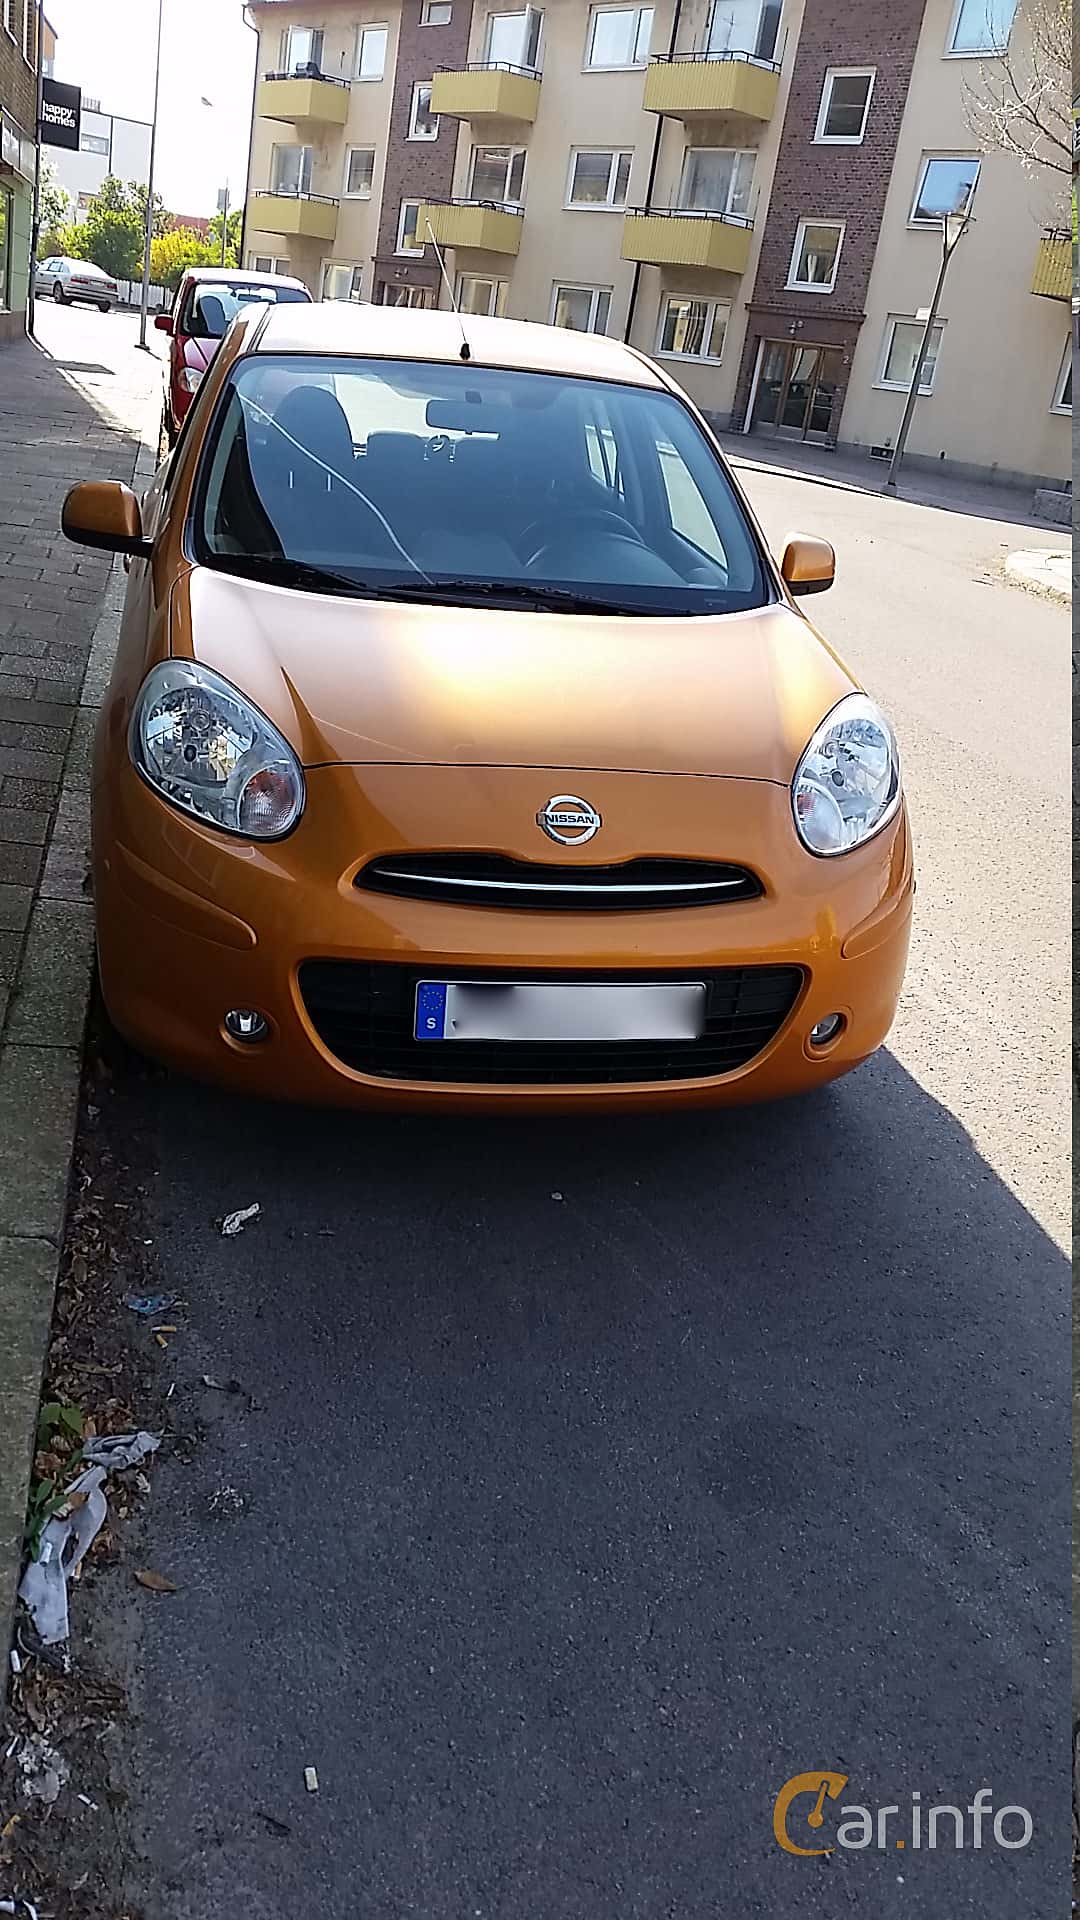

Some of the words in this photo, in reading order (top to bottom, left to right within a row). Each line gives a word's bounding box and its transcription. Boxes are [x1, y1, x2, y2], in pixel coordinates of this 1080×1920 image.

[42, 100, 73, 119] happy
[42, 112, 76, 128] homes
[545, 814, 595, 824] NISSAN
[426, 1017, 437, 1030] S
